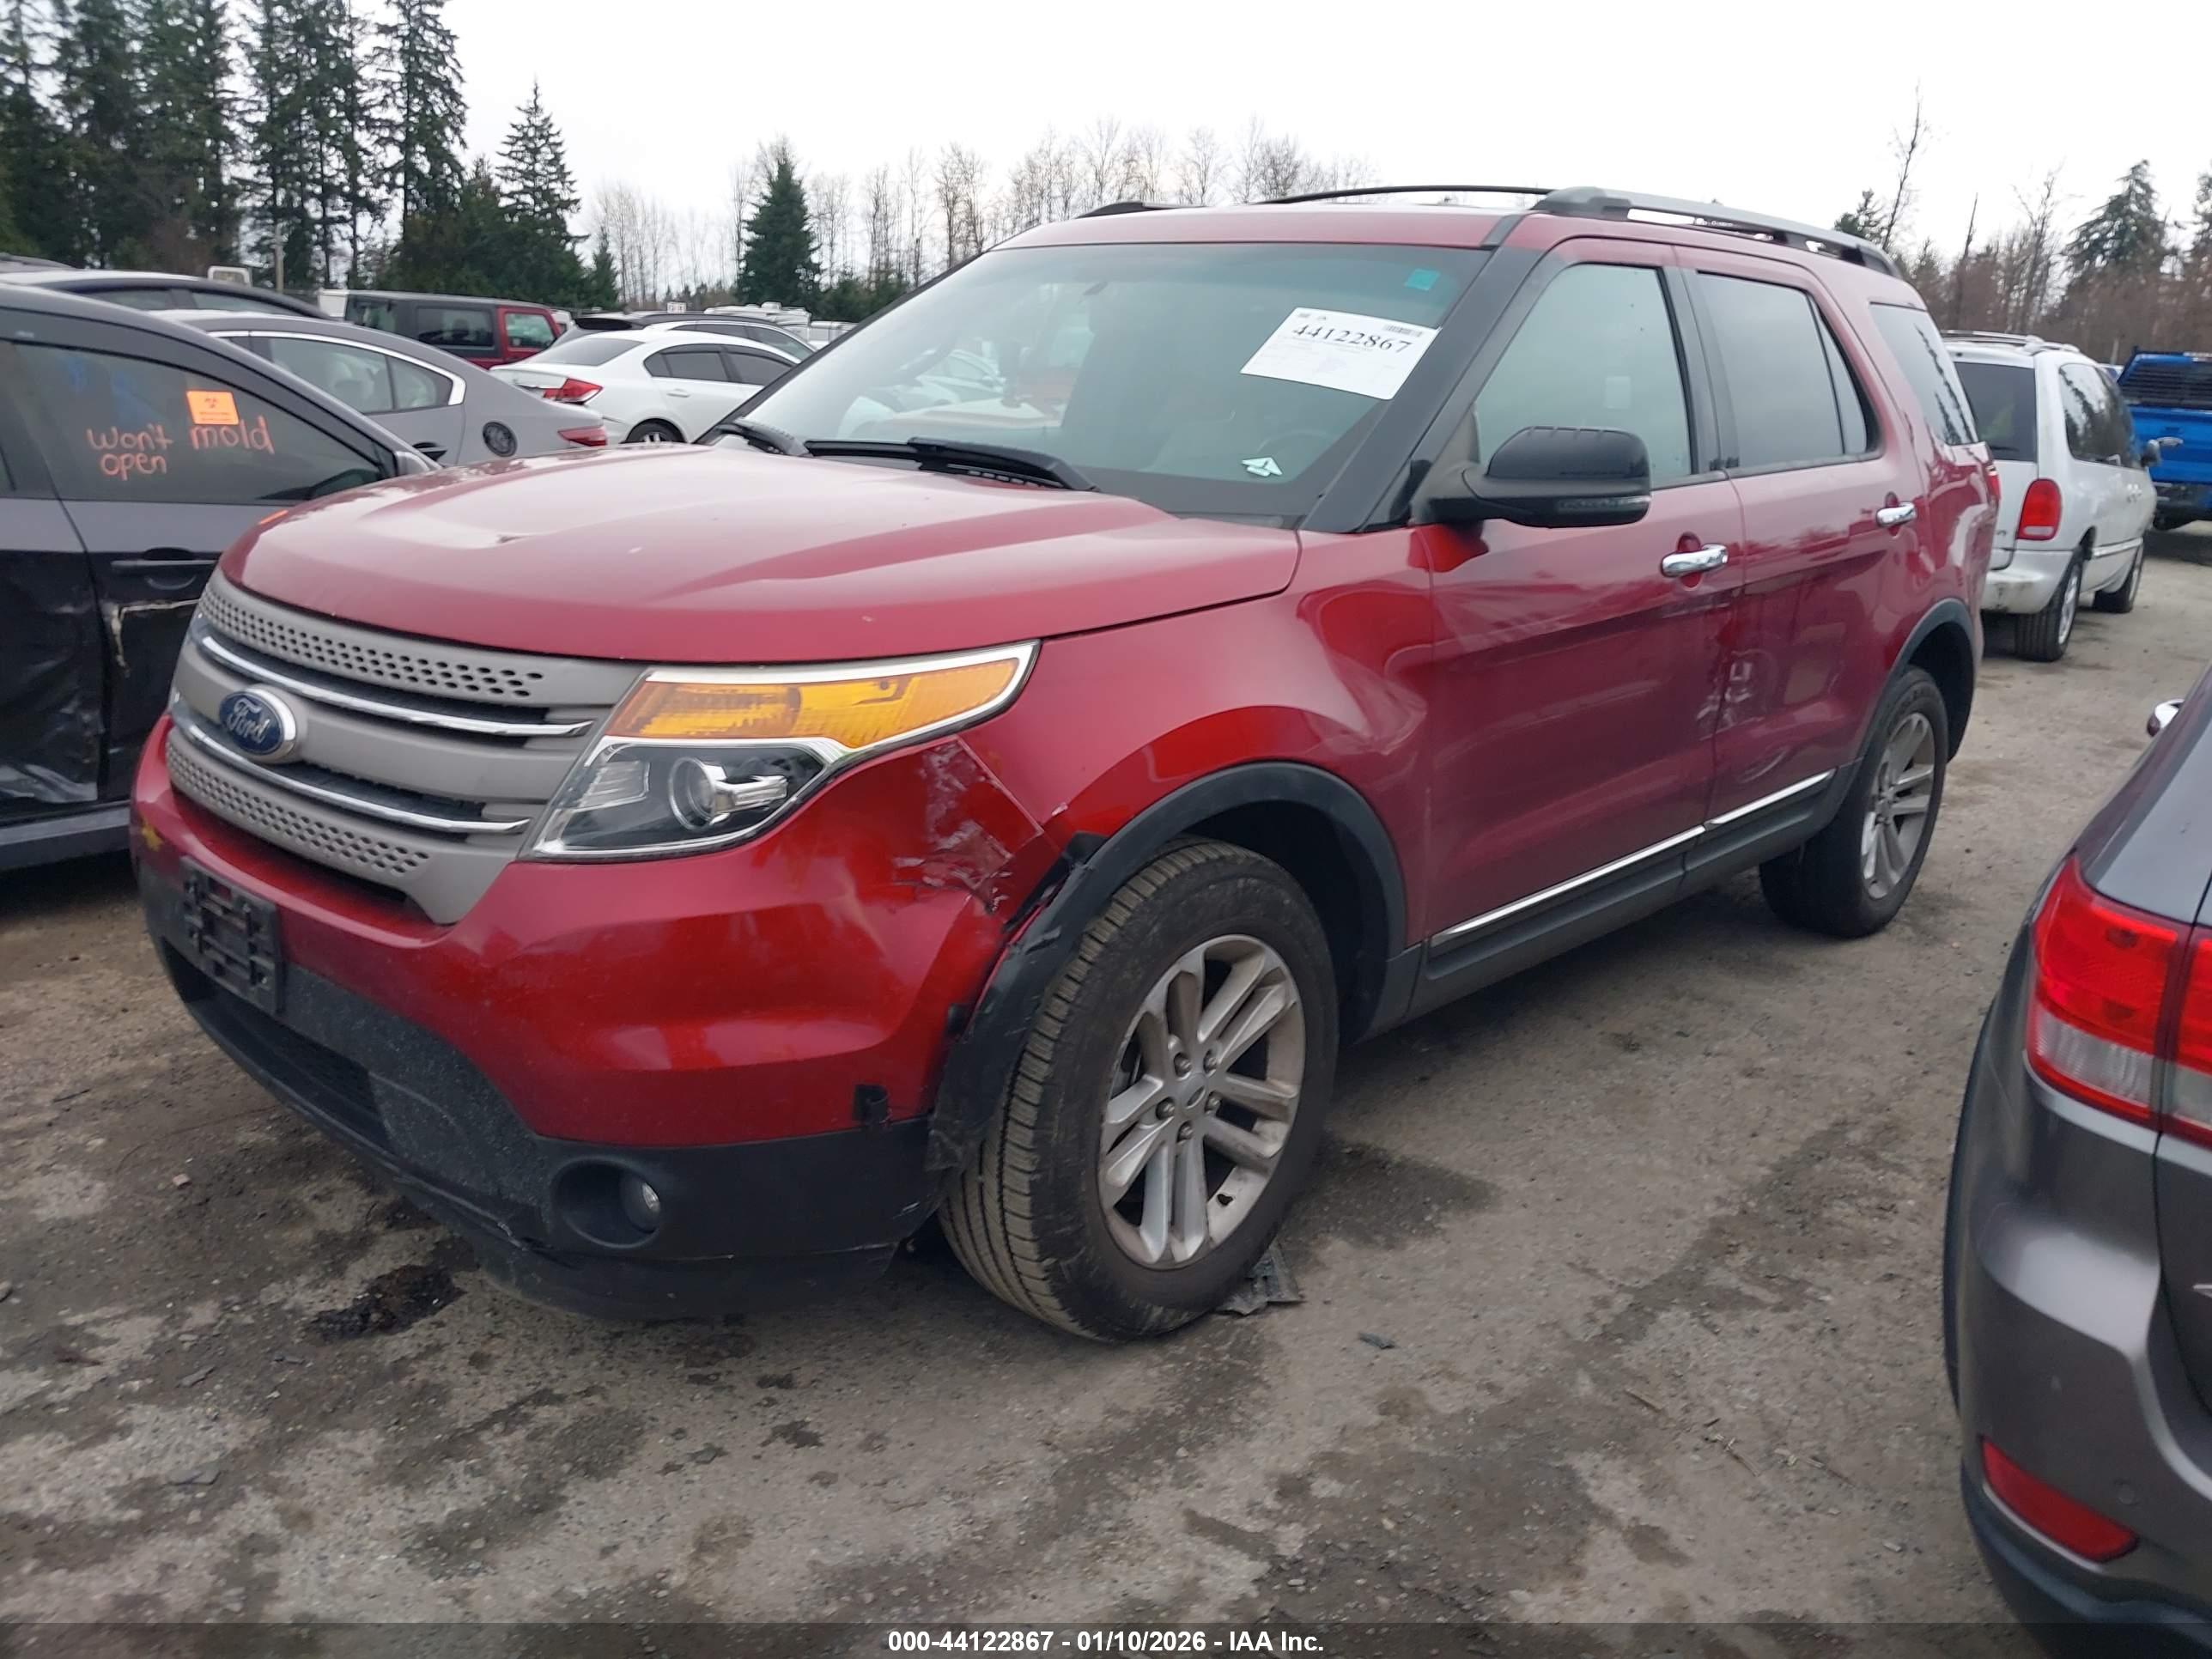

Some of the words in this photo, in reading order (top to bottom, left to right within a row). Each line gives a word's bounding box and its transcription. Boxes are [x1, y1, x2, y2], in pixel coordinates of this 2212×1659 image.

[1291, 325, 1413, 353] 44122867
[190, 416, 275, 454] mold
[100, 453, 167, 481] open
[226, 697, 270, 744] Ford
